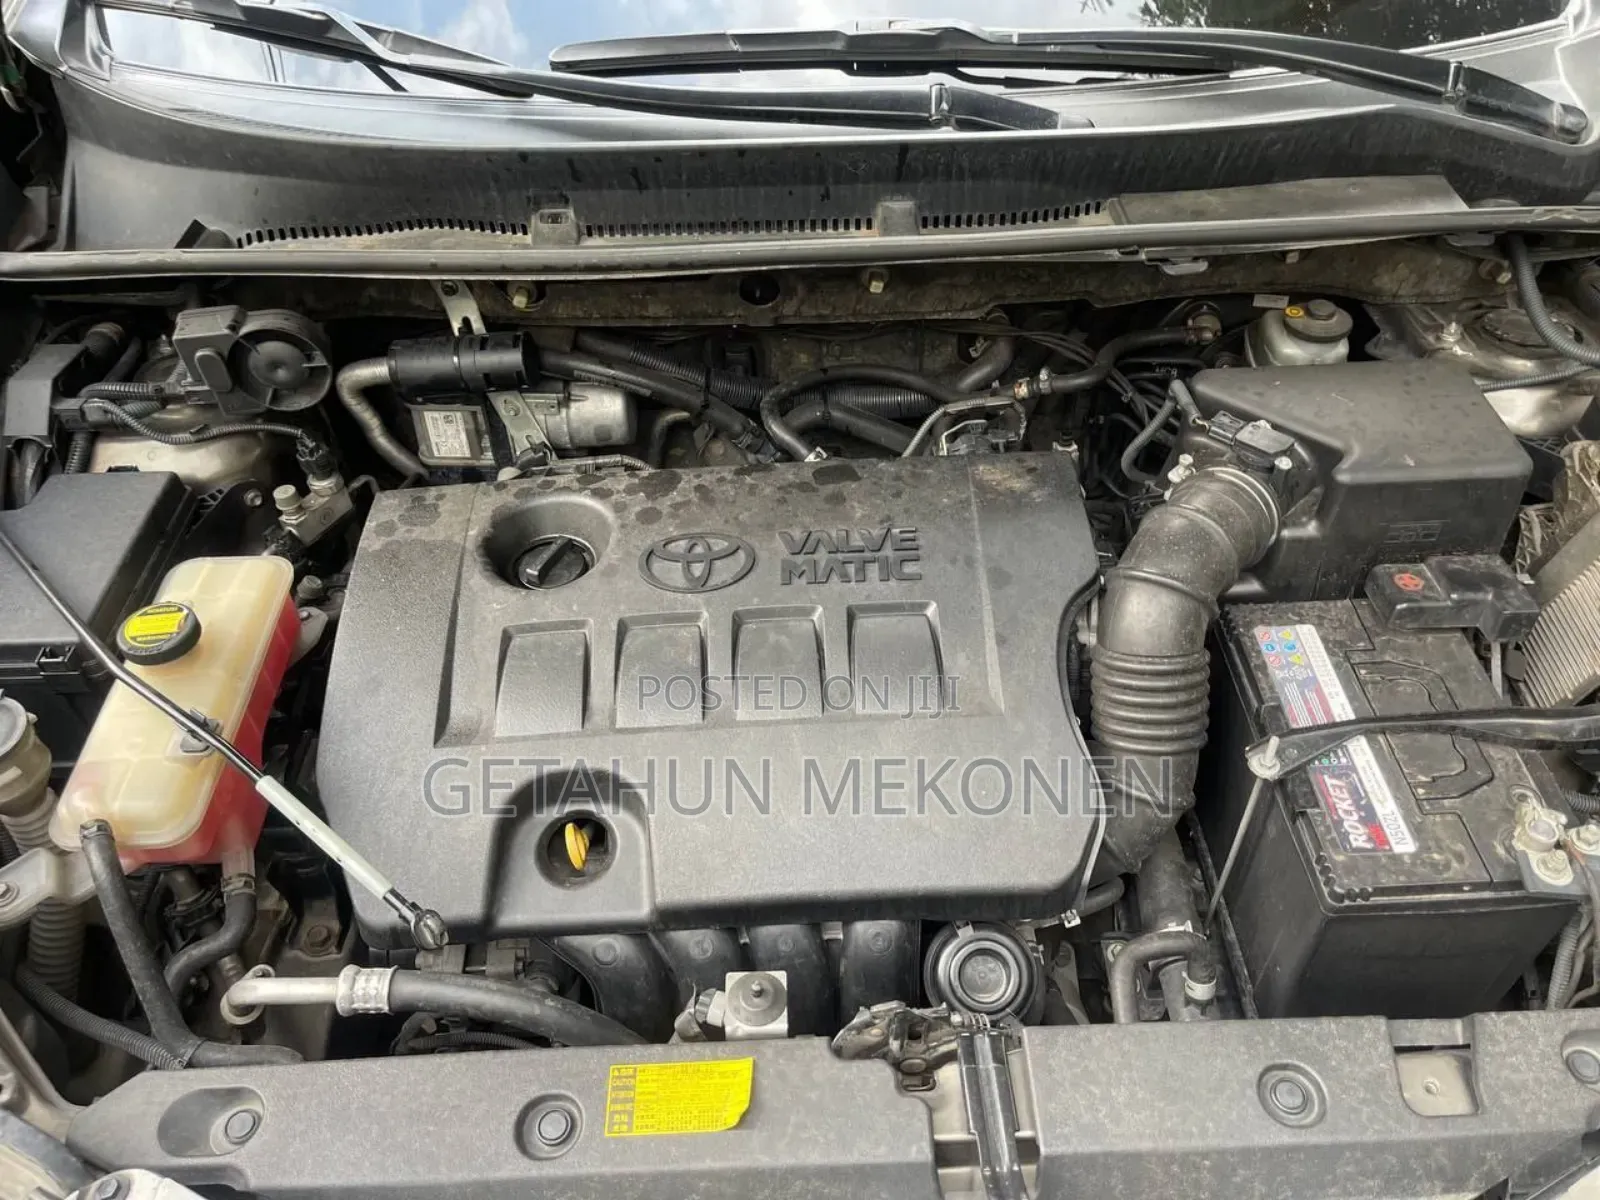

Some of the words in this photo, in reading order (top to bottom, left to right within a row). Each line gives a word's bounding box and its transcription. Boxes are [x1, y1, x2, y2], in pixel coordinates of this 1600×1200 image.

[777, 527, 919, 555] VALVE
[780, 554, 922, 585] MATIC
[1323, 775, 1374, 849] ROCKET
